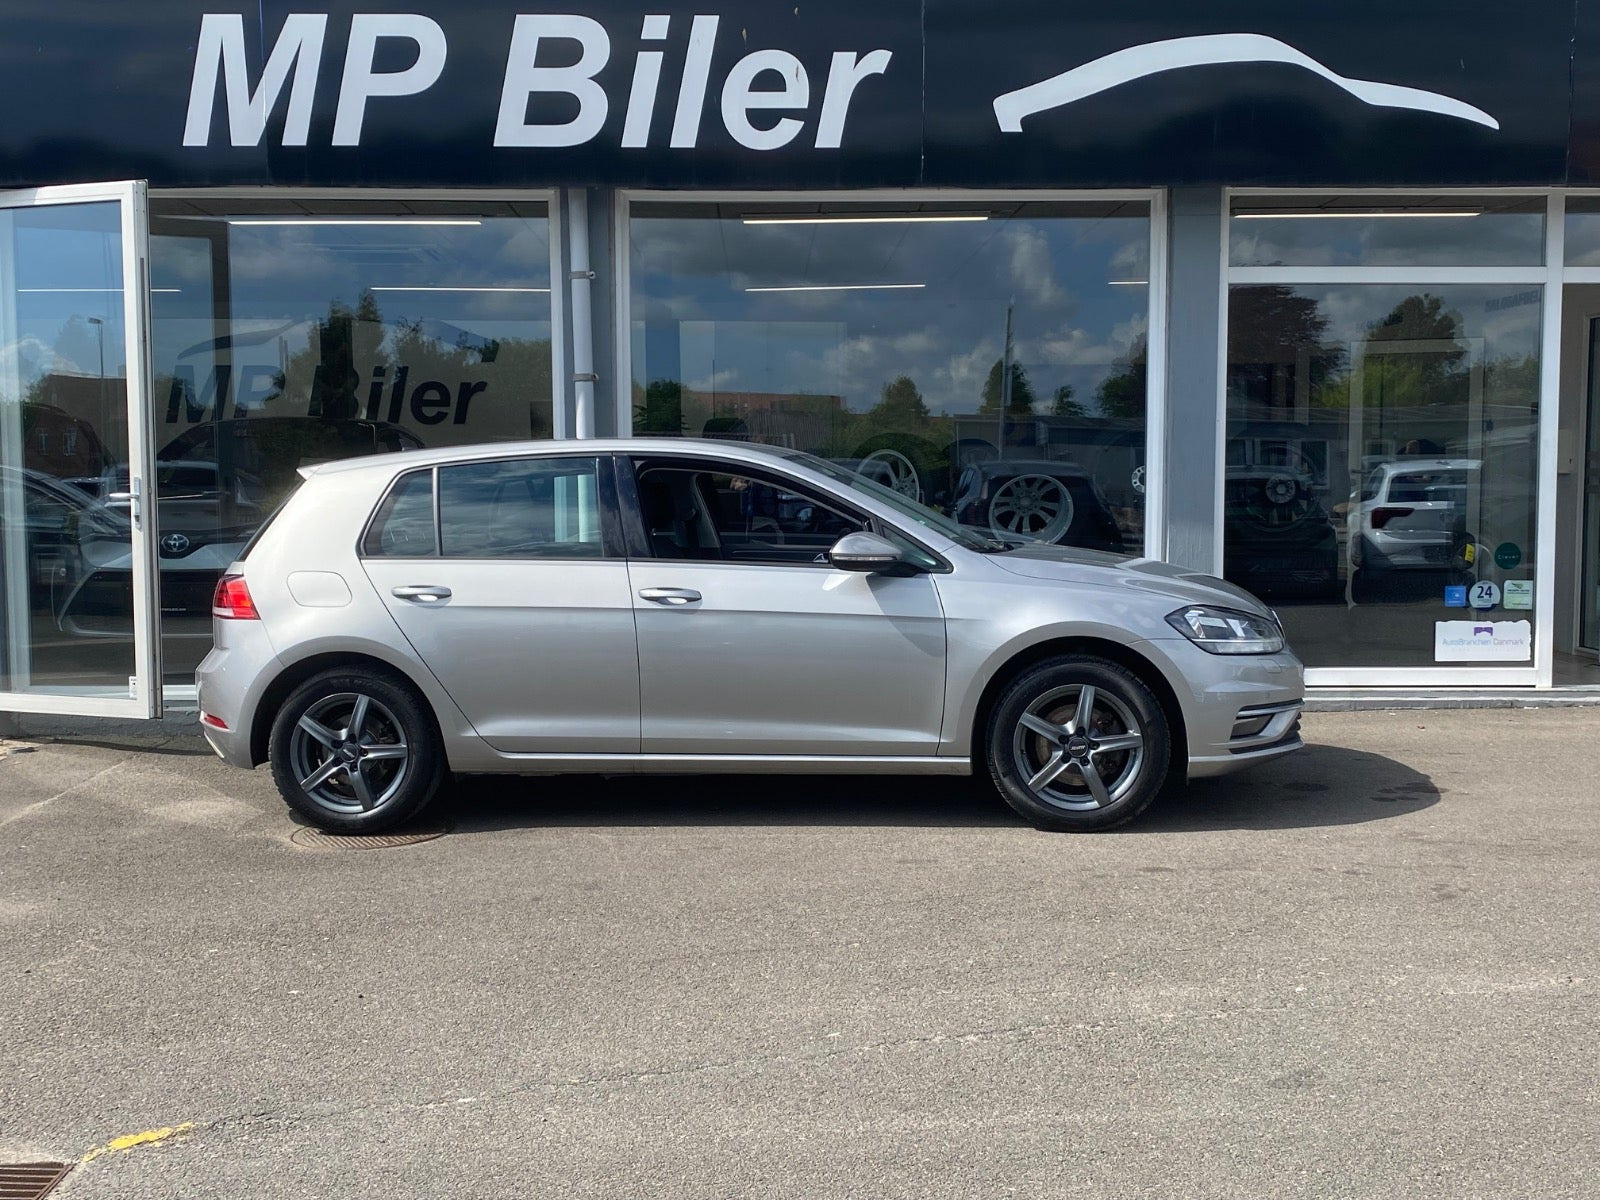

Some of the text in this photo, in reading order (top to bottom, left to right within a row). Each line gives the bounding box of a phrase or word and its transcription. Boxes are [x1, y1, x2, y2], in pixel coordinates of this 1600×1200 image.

[182, 13, 893, 151] MP Biler
[165, 364, 488, 425] MP Biler
[1477, 586, 1493, 598] 24
